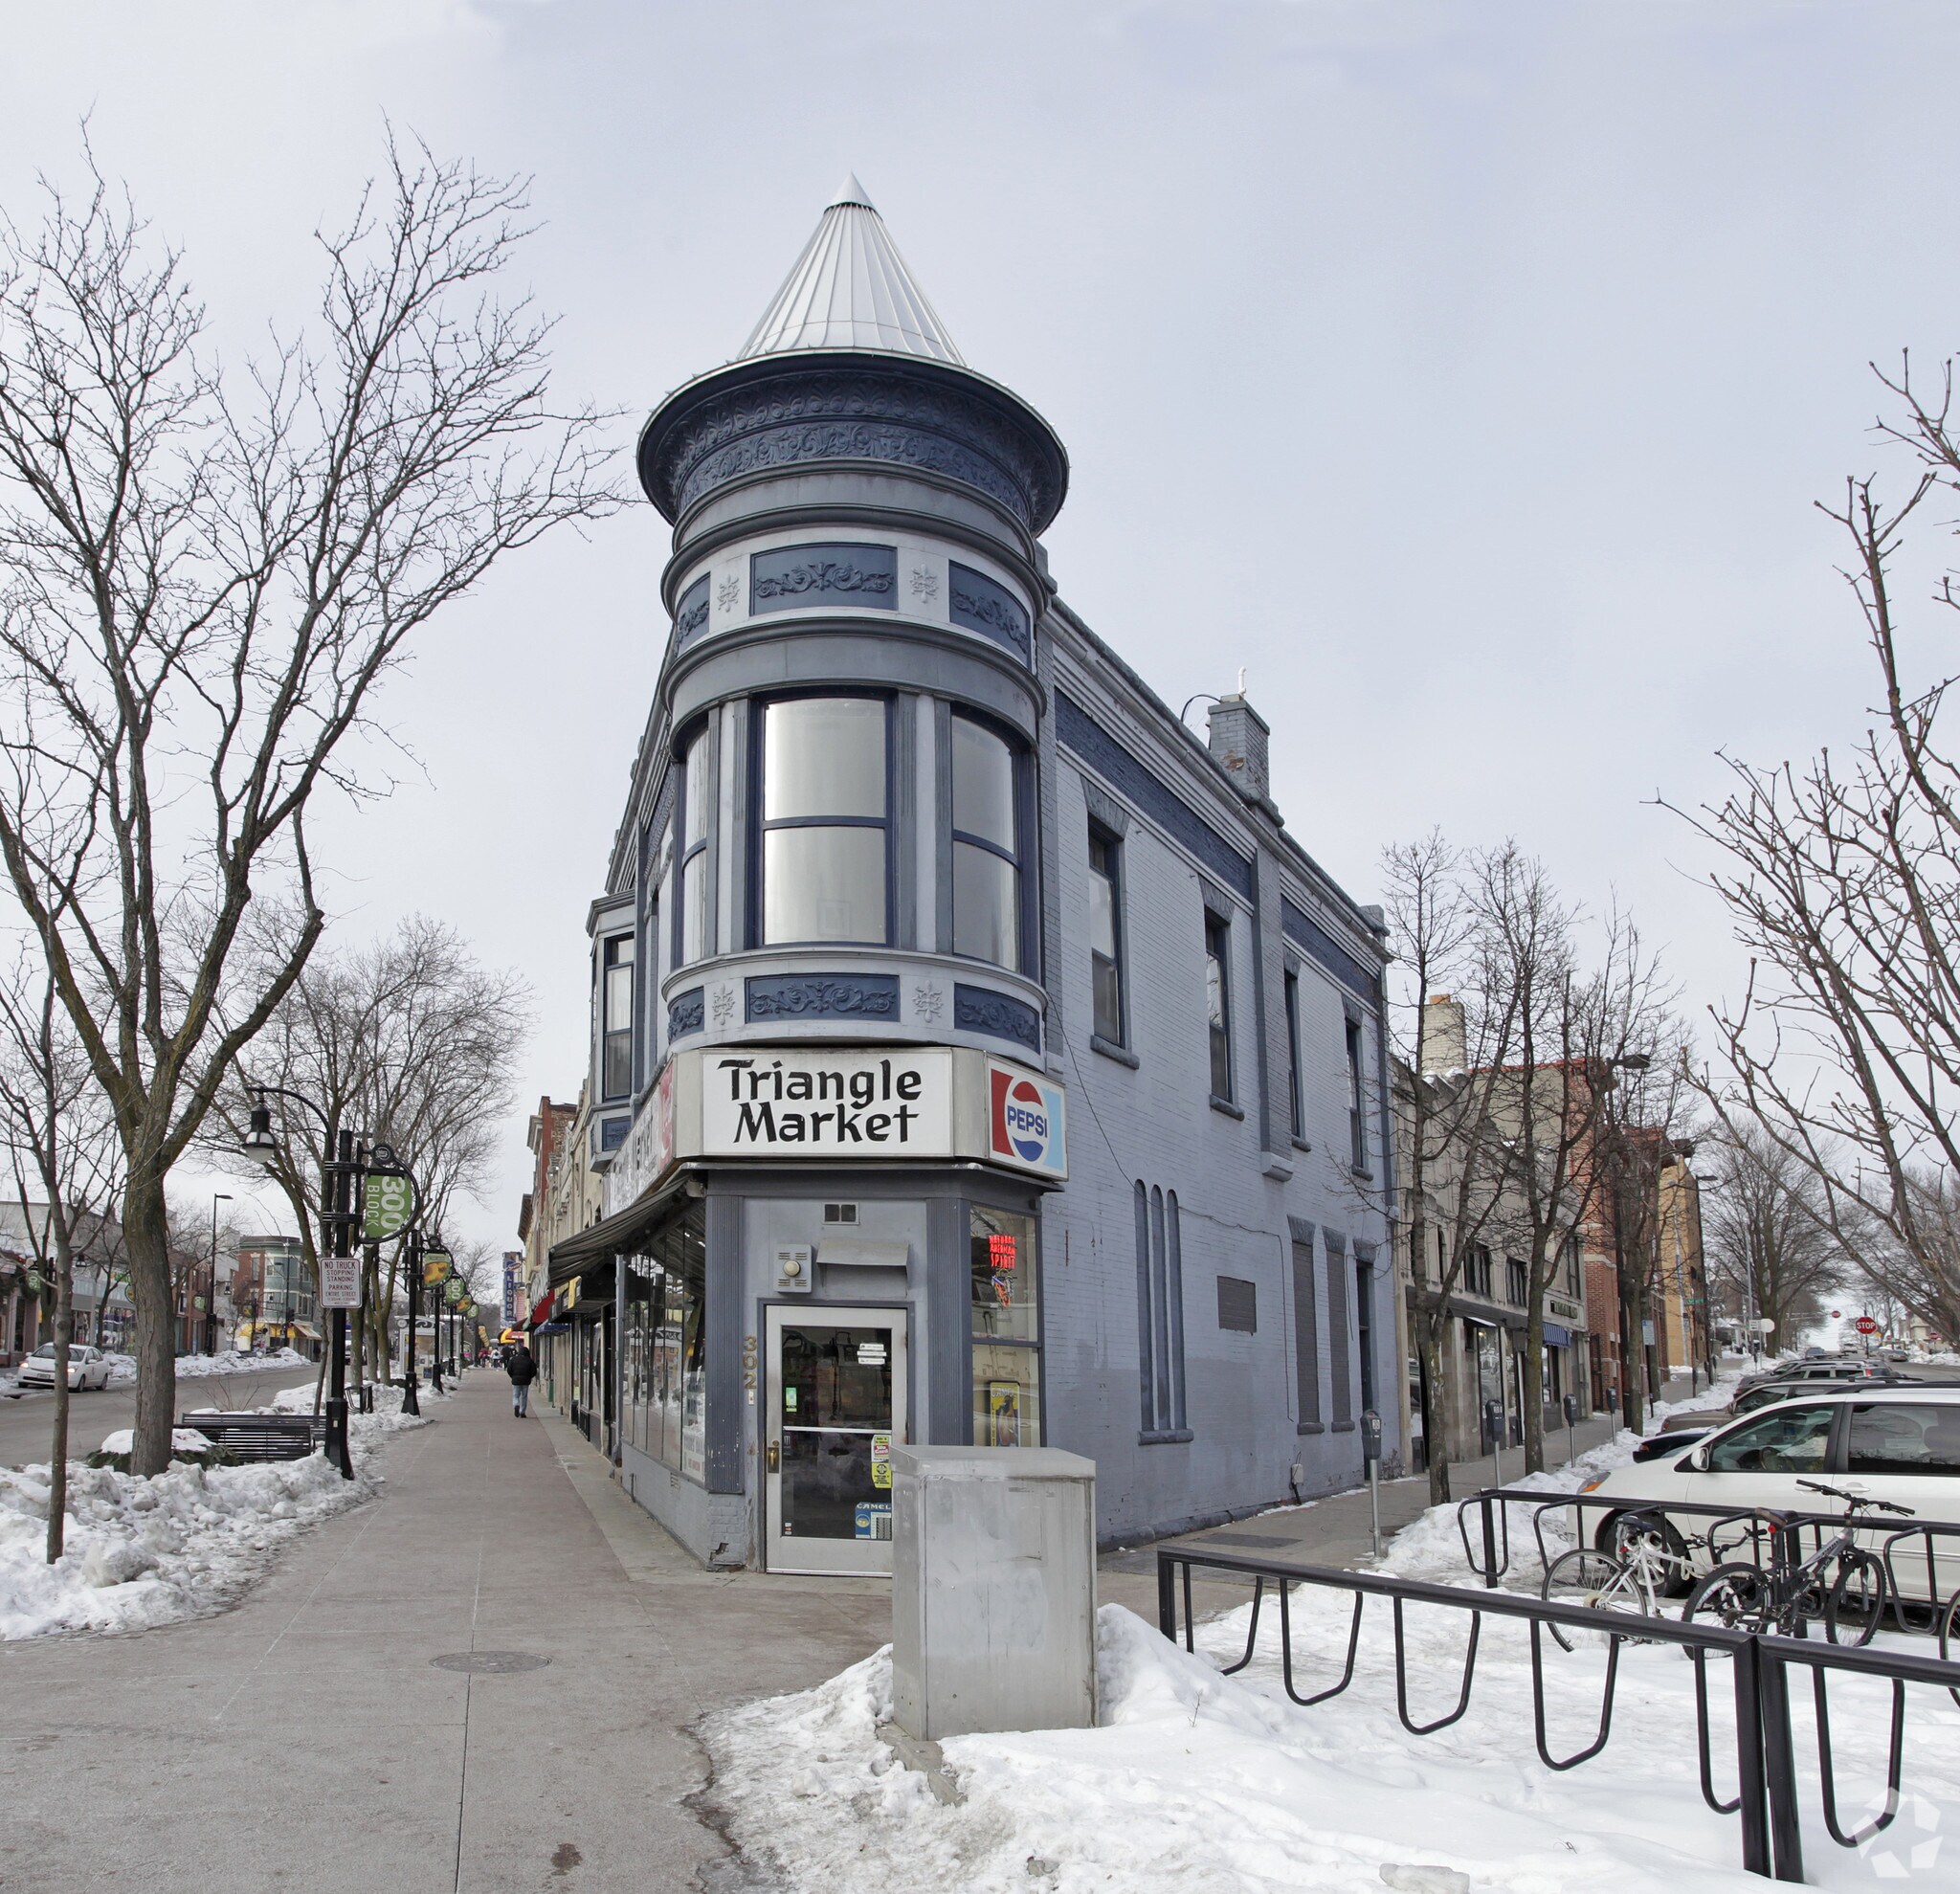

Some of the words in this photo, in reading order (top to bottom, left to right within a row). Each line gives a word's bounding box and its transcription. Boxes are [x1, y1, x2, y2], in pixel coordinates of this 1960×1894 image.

[717, 1058, 923, 1110] Triangle
[733, 1102, 920, 1143] Market
[1007, 1104, 1048, 1138] PEPSI
[366, 1184, 380, 1227] BLOCK
[381, 1175, 406, 1230] 300
[324, 1261, 334, 1270] NO
[336, 1261, 356, 1270] TRUCK
[991, 1253, 1016, 1270] SPIRIT
[451, 1278, 461, 1300] 300
[743, 1335, 758, 1390] 302
